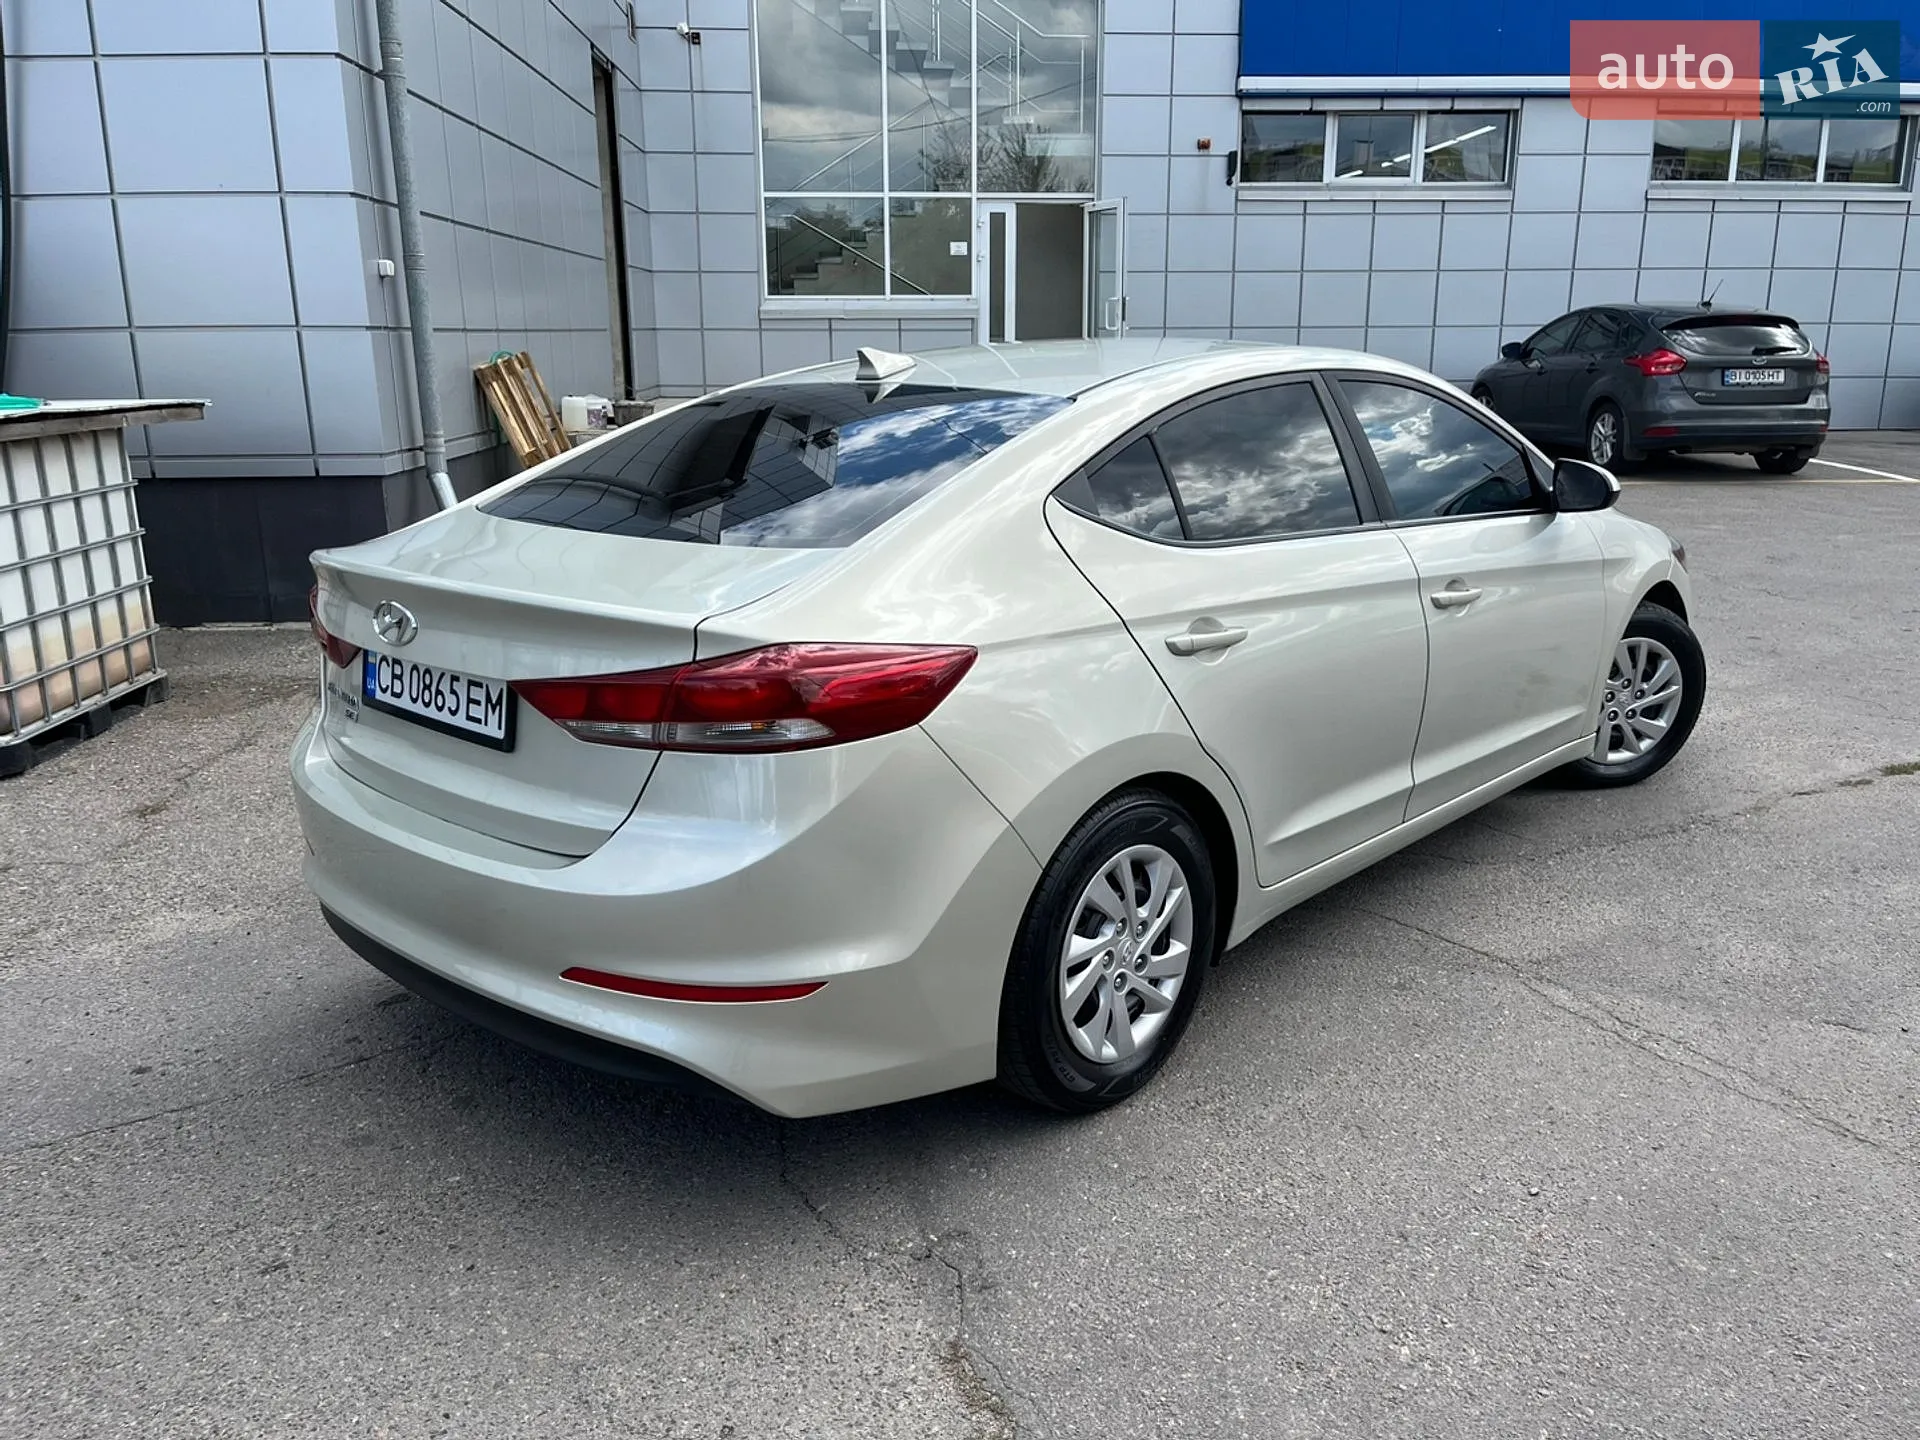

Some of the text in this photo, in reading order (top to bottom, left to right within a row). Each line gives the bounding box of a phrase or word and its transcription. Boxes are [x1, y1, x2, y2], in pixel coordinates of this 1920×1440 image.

[378, 655, 404, 699] CB
[409, 663, 460, 717] 0865
[465, 679, 504, 731] EM
